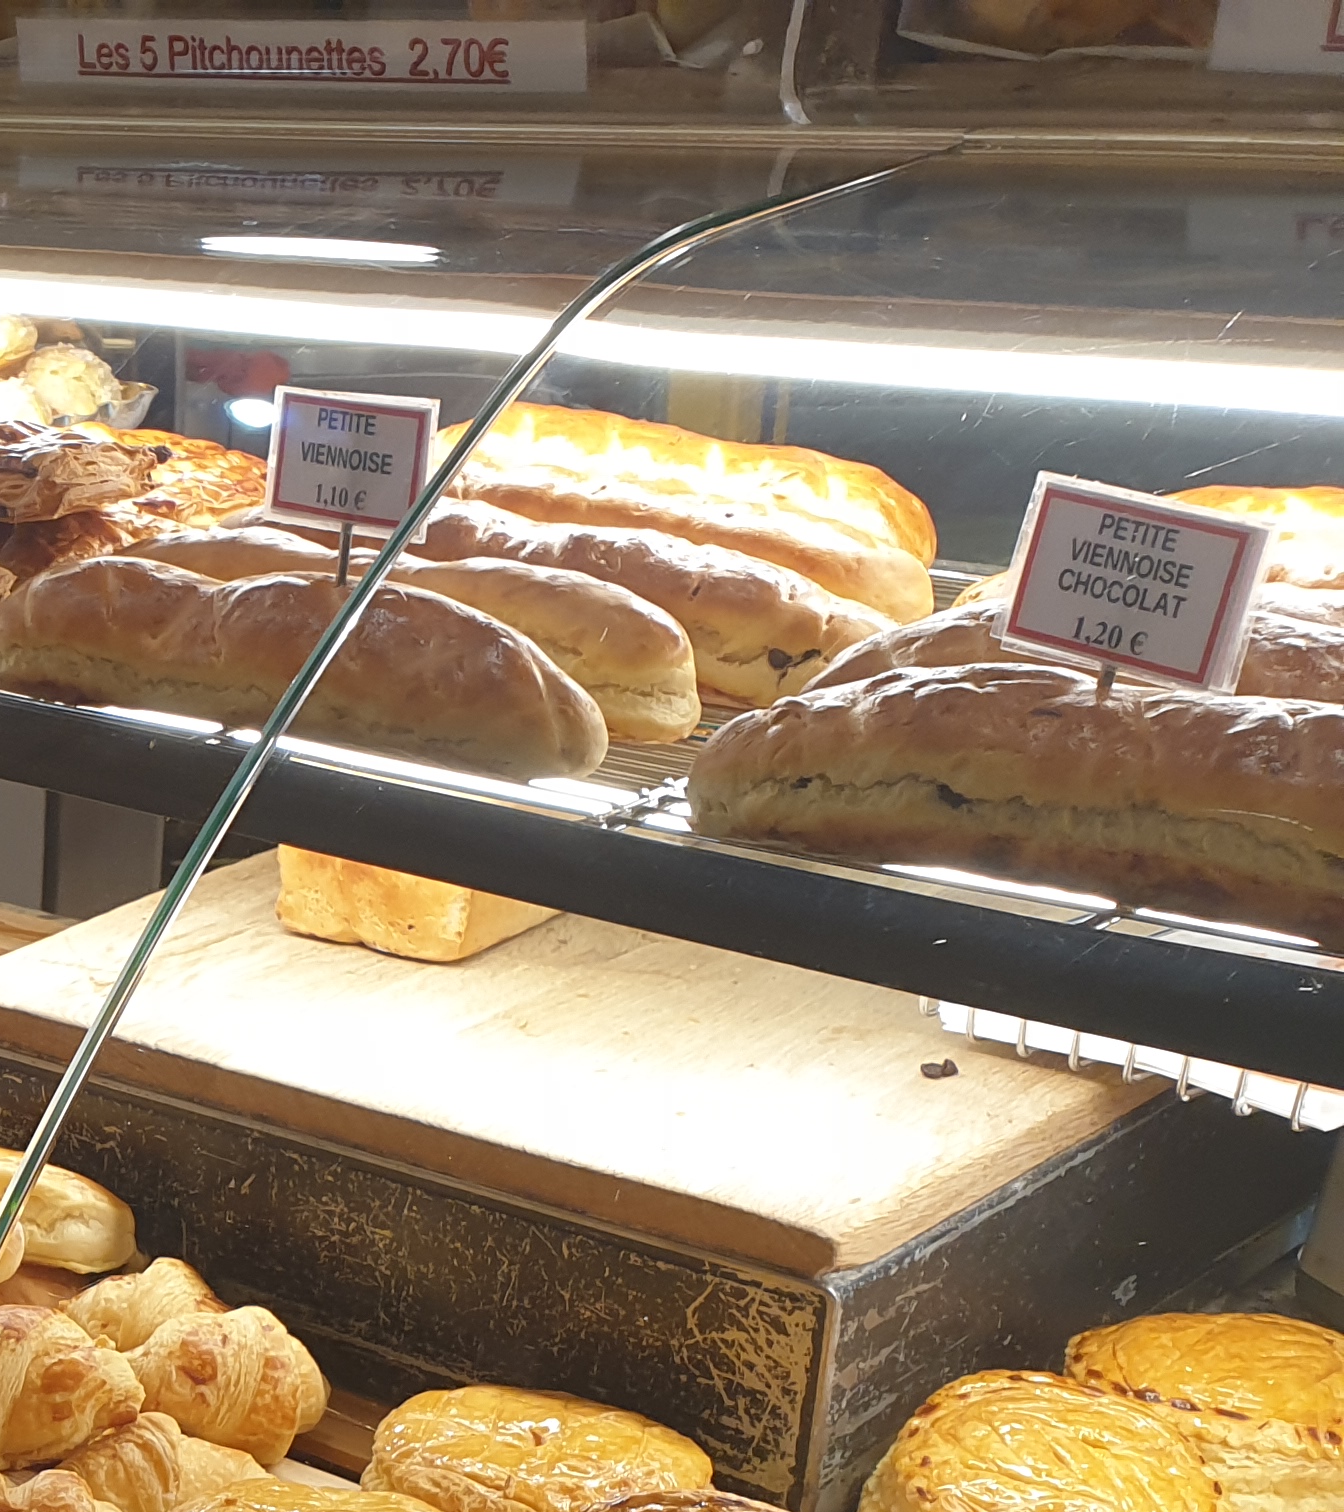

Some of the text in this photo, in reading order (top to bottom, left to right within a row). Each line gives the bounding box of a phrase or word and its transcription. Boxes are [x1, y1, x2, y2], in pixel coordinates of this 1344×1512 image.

[78, 34, 510, 79] Les 5 Pitchounettes 2,70€
[317, 408, 377, 436] PETITE
[301, 441, 393, 475] VIENNOISE
[315, 484, 367, 511] 1,10 €
[1098, 513, 1179, 553] PETITE
[1071, 537, 1194, 589] VIENNOISE
[1058, 568, 1188, 619] CHOCOLAT
[1071, 616, 1148, 656] 1,20 €
